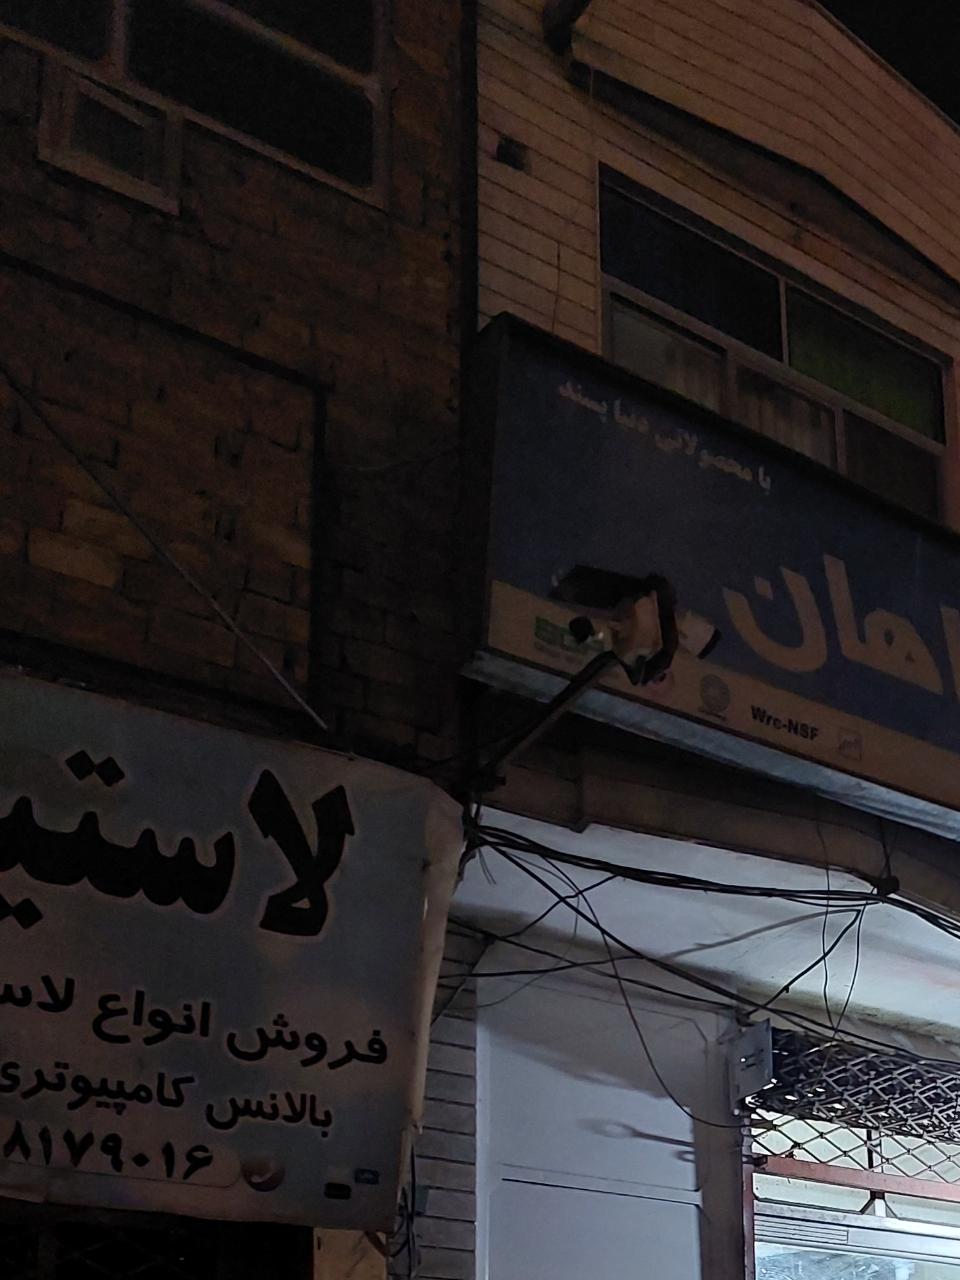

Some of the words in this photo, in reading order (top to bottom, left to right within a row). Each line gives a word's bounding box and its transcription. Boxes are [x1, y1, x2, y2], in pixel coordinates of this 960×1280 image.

[751, 704, 819, 741] Wrc-NSF
[0, 750, 355, 936] لاستی
[92, 990, 211, 1046] انواع
[227, 1013, 388, 1070] فروش
[0, 1061, 195, 1115] کامپیوتری
[206, 1091, 333, 1138] بالانس
